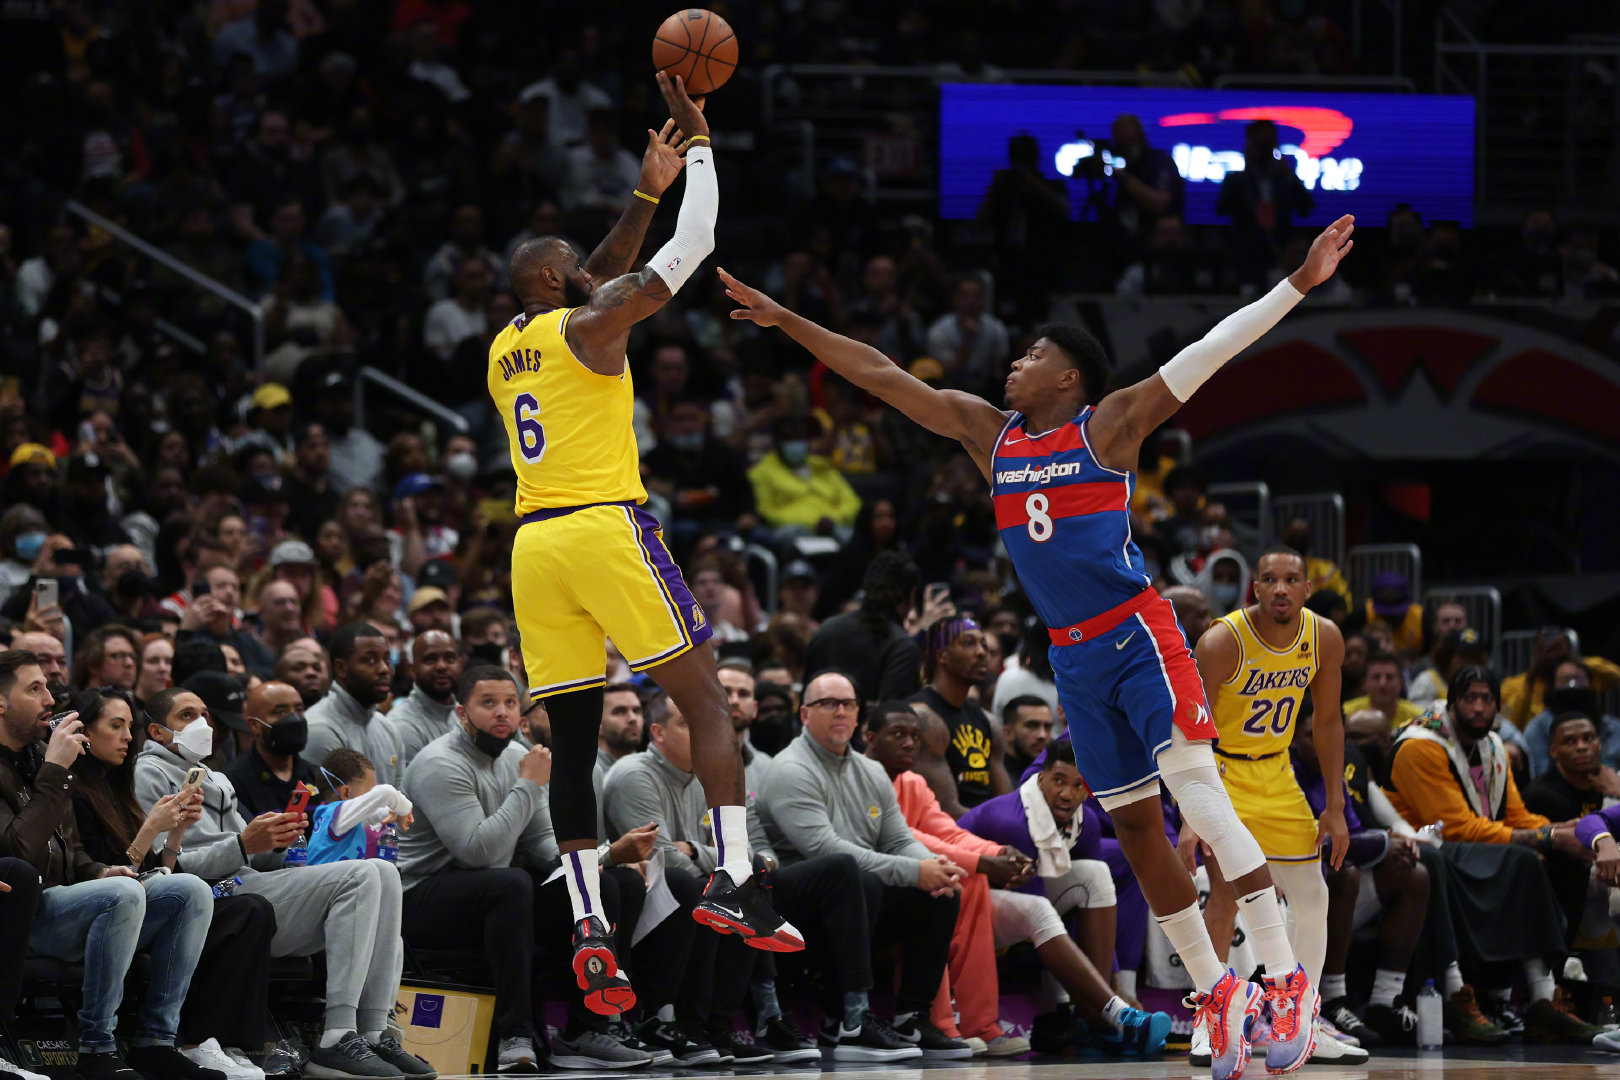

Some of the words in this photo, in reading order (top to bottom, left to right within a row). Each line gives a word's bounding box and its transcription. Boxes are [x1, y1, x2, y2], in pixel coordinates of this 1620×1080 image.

[498, 348, 542, 381] JAMES
[514, 391, 547, 465] 6
[996, 462, 1081, 485] washington
[1025, 491, 1055, 543] 8
[1236, 666, 1311, 696] LAKERS
[1241, 695, 1296, 737] 20
[36, 1040, 71, 1050] CAESARS
